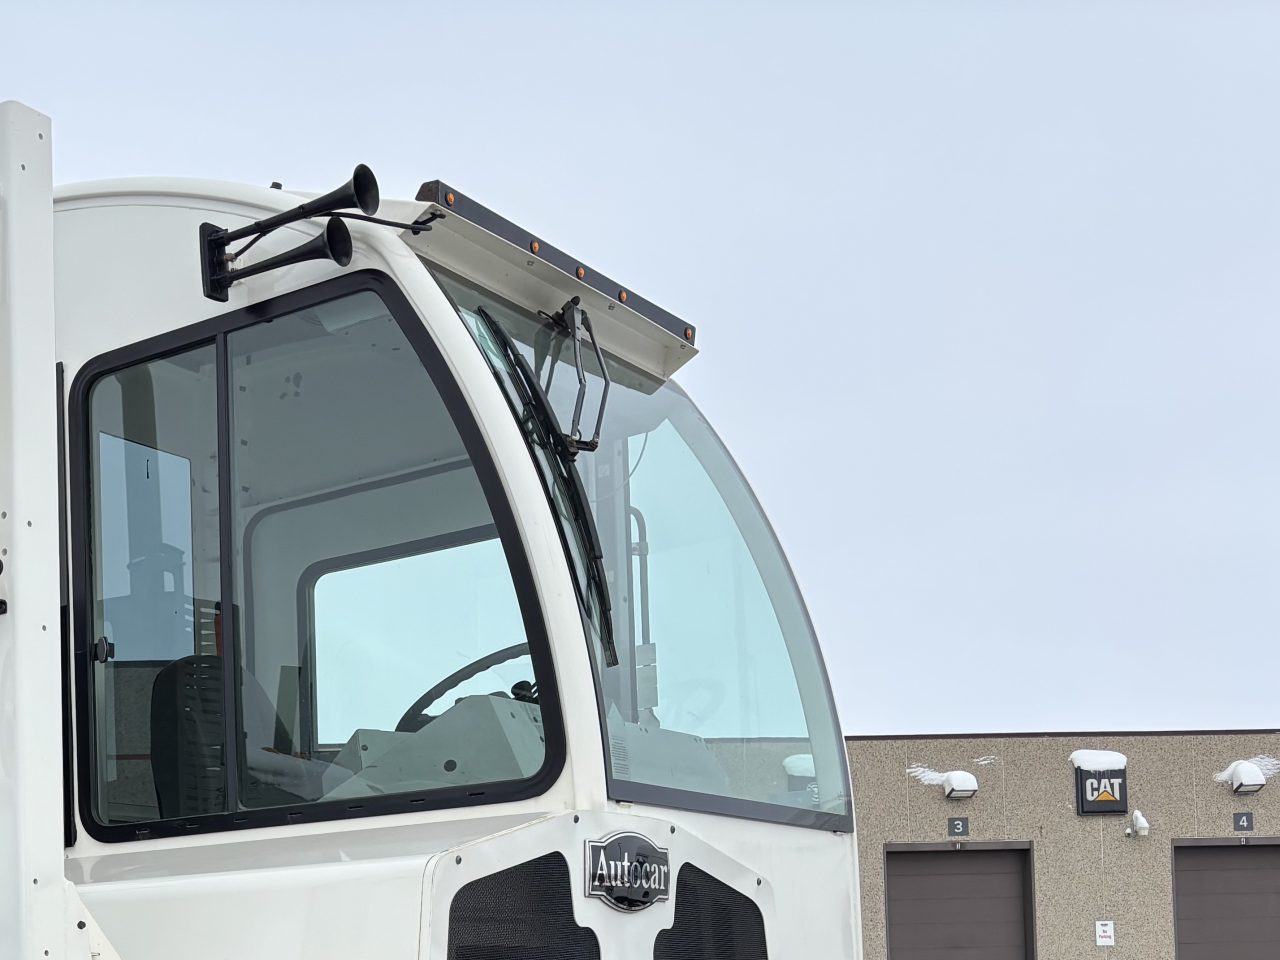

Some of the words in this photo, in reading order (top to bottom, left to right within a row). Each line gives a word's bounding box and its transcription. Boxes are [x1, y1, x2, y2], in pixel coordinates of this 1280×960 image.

[1086, 778, 1122, 801] CAT
[954, 820, 963, 832] 3
[1239, 815, 1248, 828] 4
[592, 848, 668, 890] Autocar
